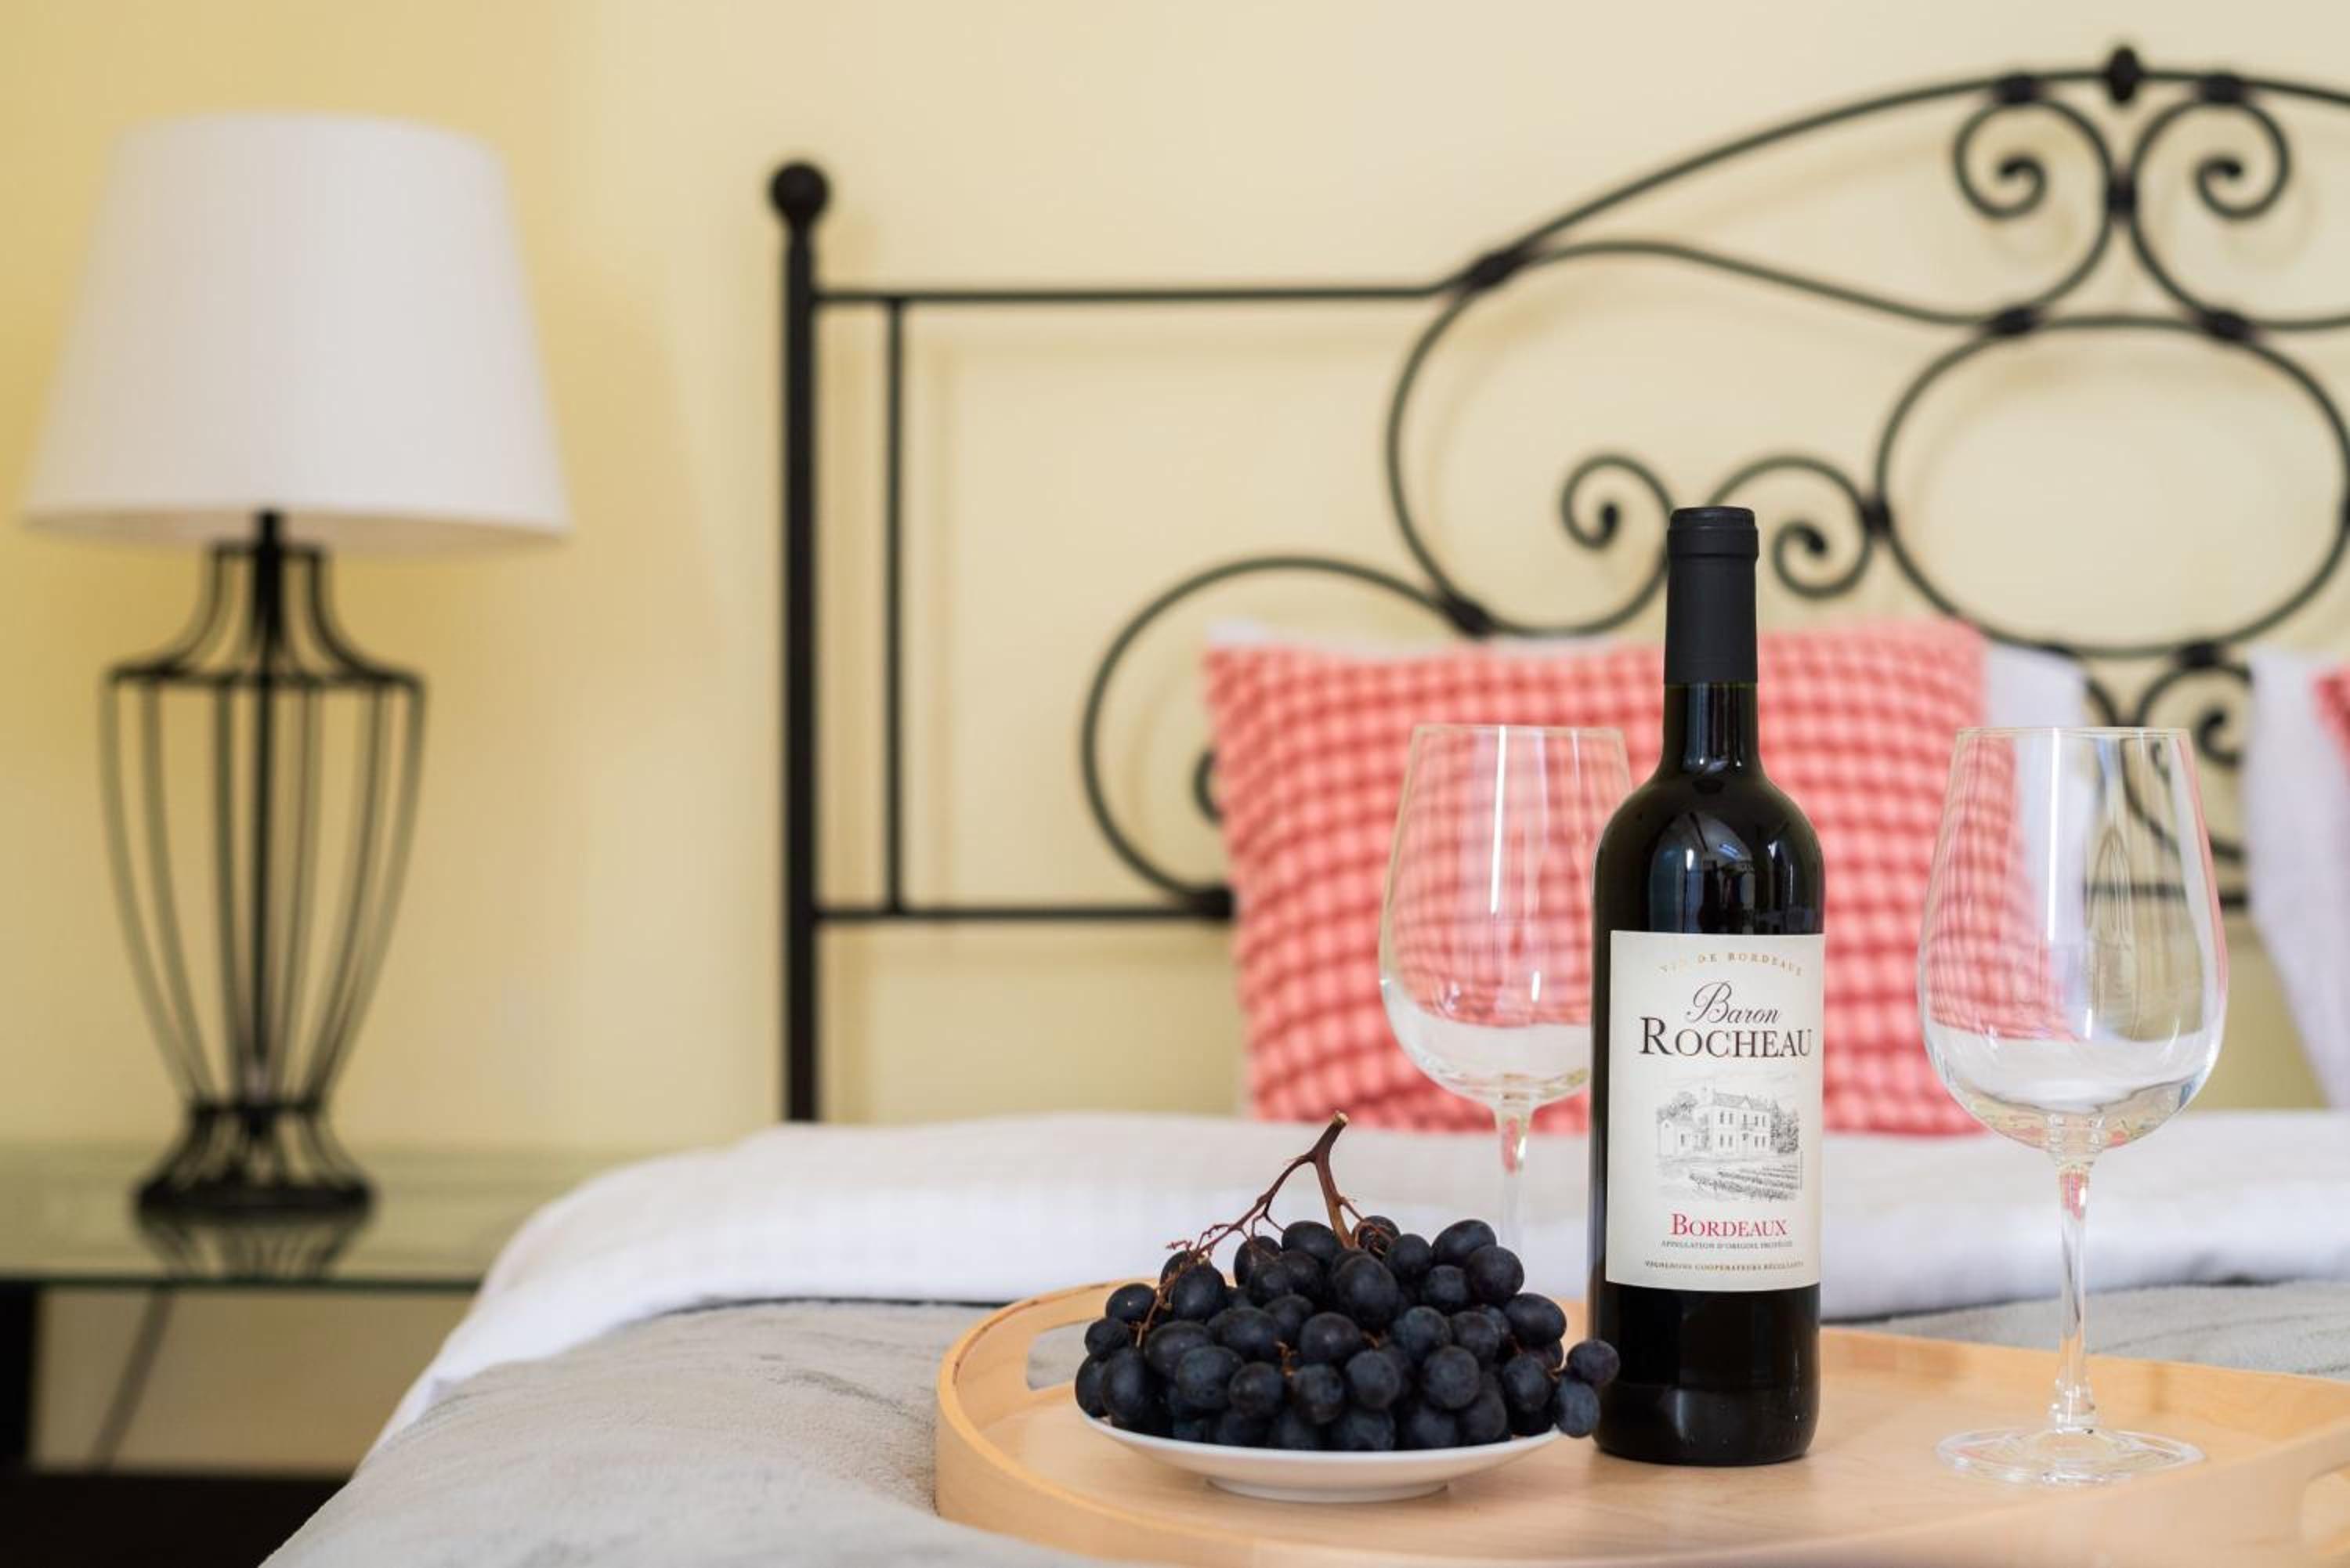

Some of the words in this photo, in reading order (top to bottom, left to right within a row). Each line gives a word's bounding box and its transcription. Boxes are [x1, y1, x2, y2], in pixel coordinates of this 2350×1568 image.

[1697, 953, 1717, 963] DE
[1686, 981, 1781, 1024] Baron
[1639, 1017, 1813, 1058] ROCHEAU
[1670, 1213, 1788, 1237] BORDEAUX
